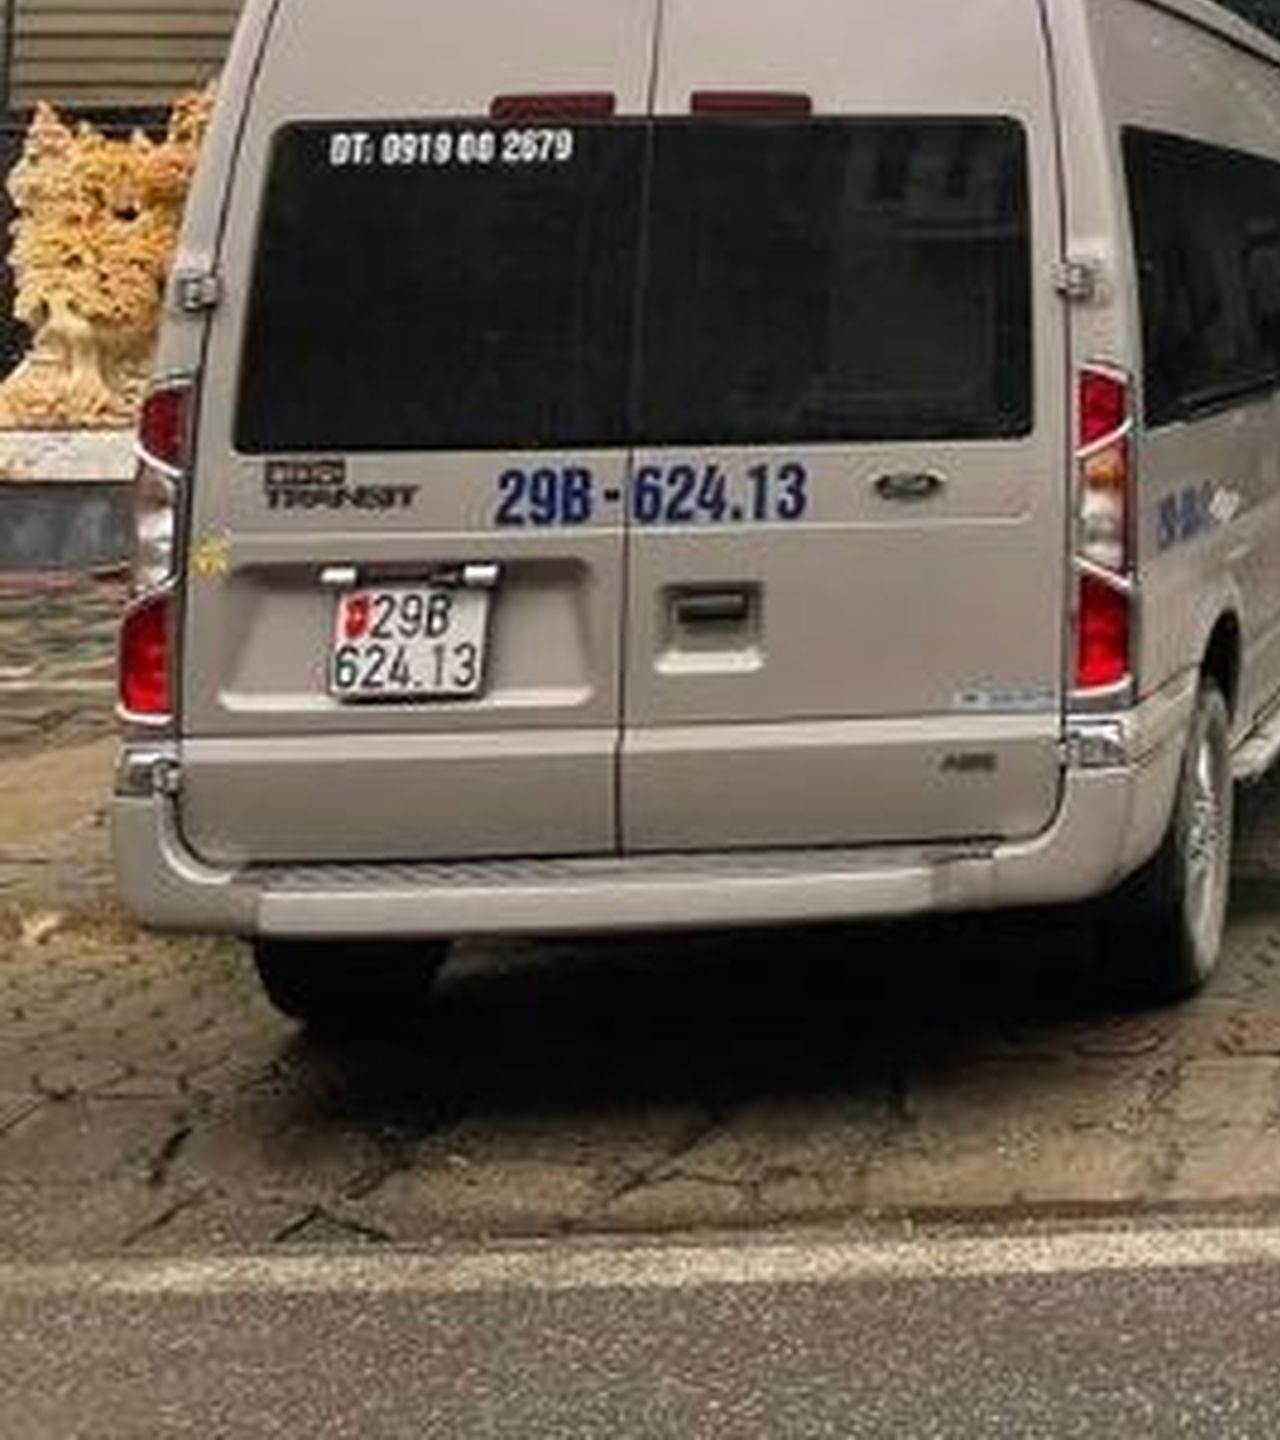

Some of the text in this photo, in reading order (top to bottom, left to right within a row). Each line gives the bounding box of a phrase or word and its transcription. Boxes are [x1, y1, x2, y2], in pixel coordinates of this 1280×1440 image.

[494, 467, 592, 527] 29B
[631, 462, 807, 522] 624.13
[368, 592, 454, 637] 29B
[334, 642, 478, 690] 624.13
